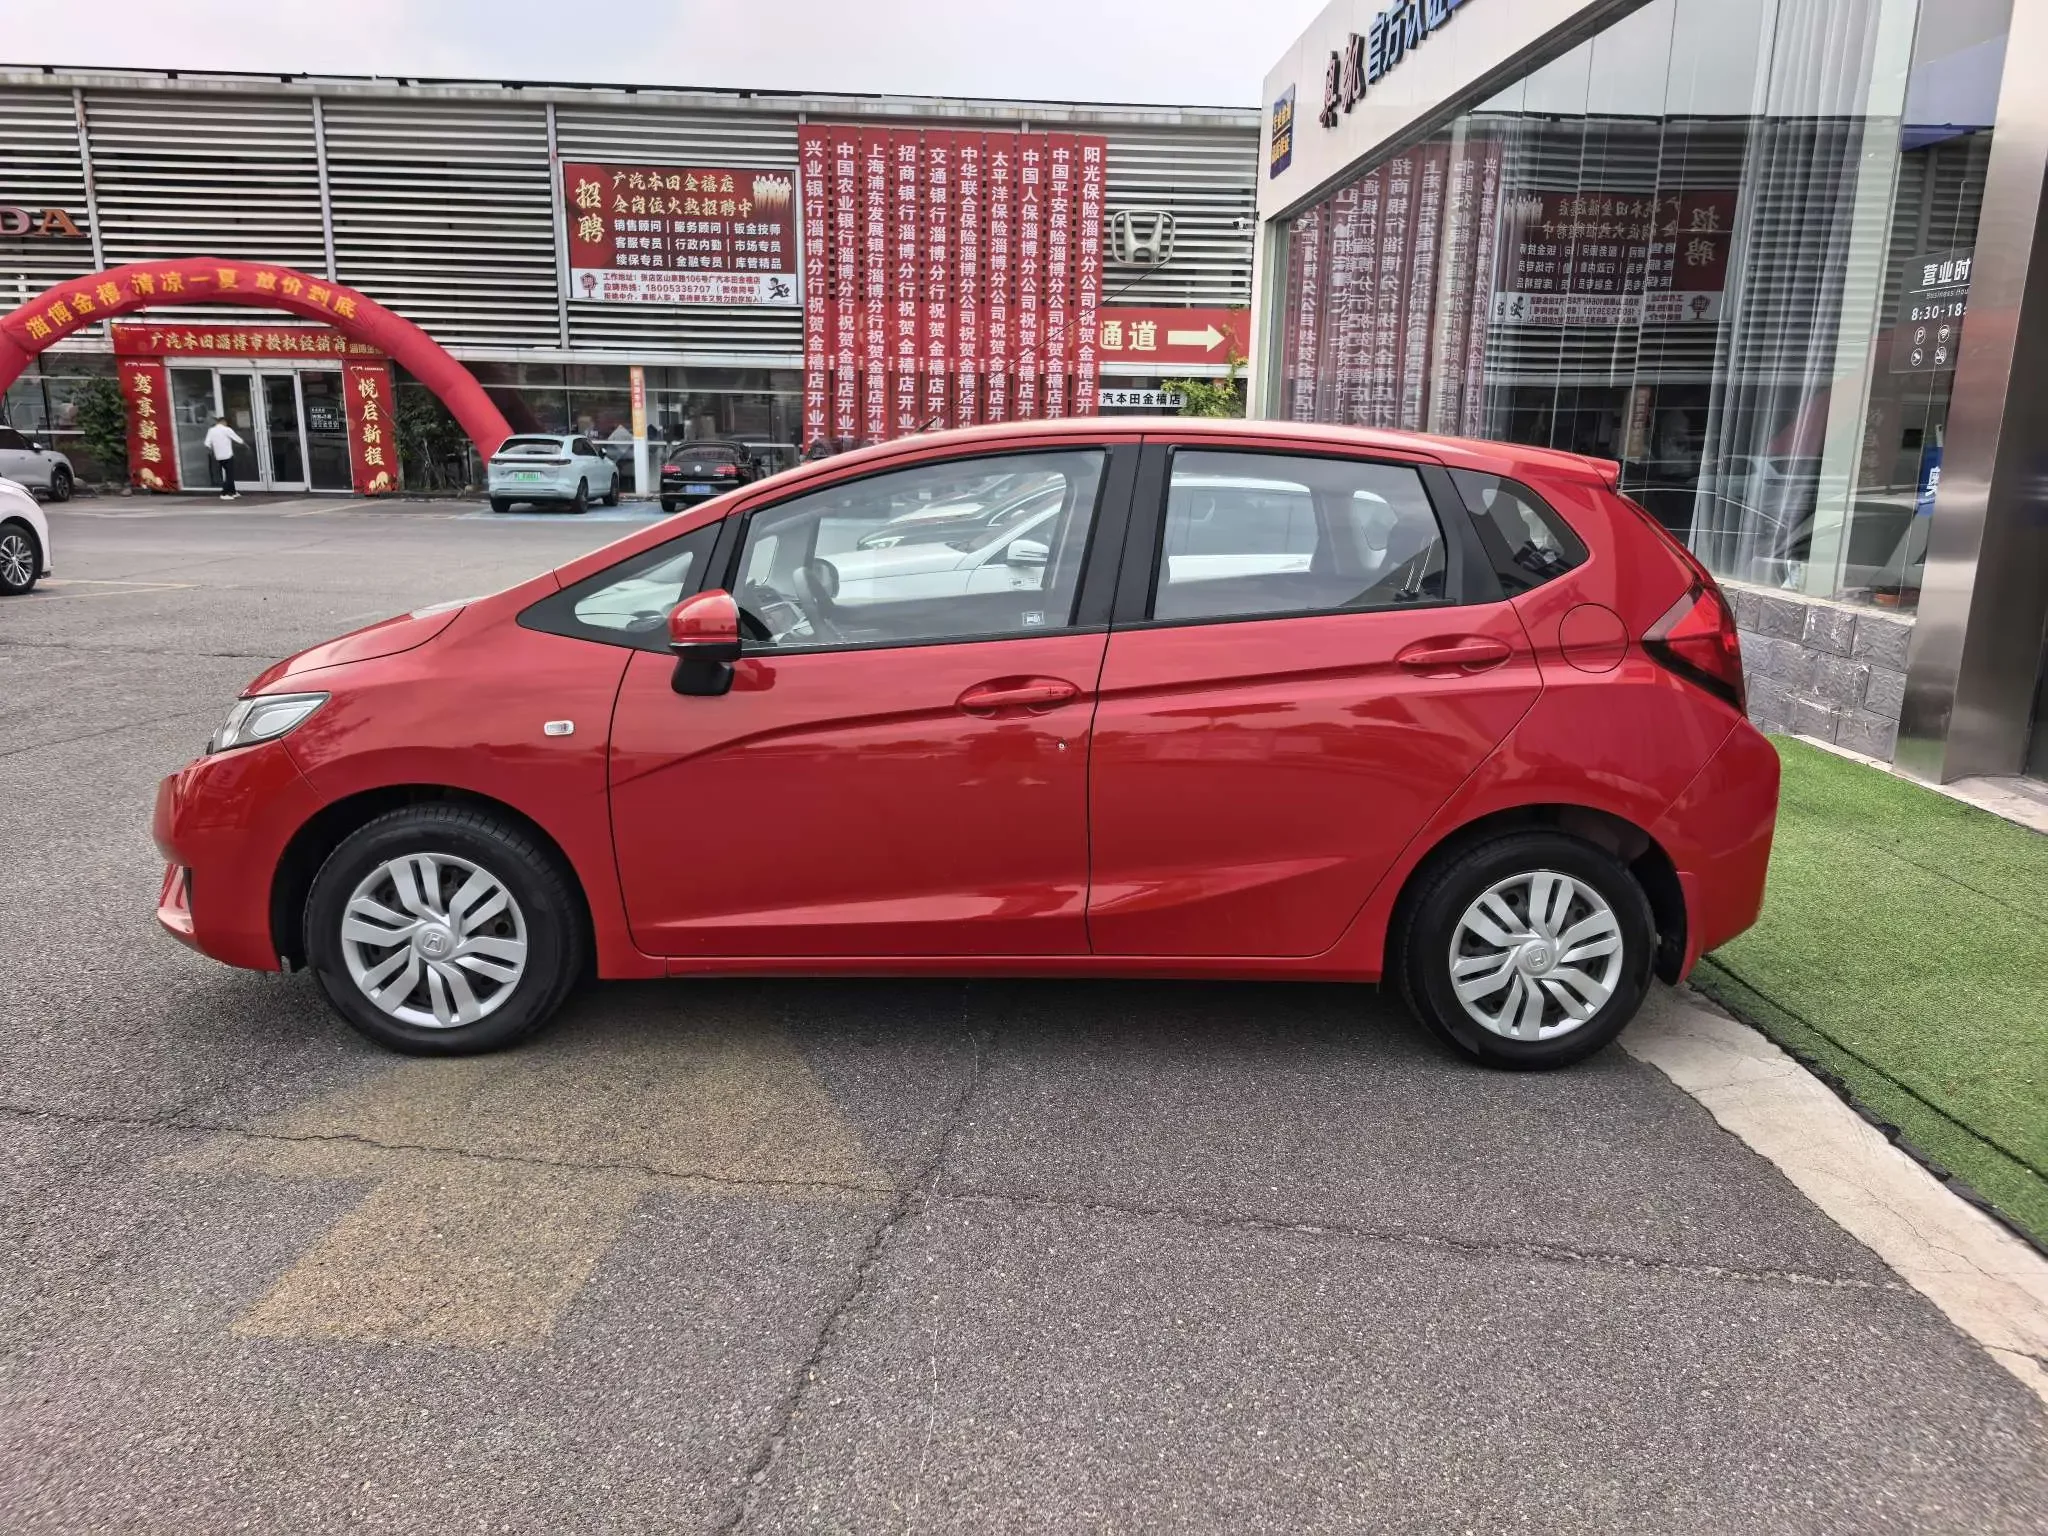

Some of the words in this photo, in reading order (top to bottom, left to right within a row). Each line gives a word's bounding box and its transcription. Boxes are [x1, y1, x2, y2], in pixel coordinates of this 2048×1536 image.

[611, 171, 735, 193] 广汽本田金禧店
[575, 178, 605, 243] 招聘
[611, 193, 753, 218] 全岗位火热招聘中
[614, 219, 662, 233] 销售顾问
[674, 221, 721, 234] 服务顾问
[734, 223, 781, 236] 钣金技师
[615, 237, 663, 250] 客服专员
[675, 239, 722, 251] 行政内勤
[735, 240, 781, 253] 市场专员
[676, 255, 723, 269] 金融专员
[1922, 258, 1971, 286] 营业时
[897, 144, 917, 435] 招商银行淄博分行祝贺金禧店开业
[1018, 148, 1040, 420] 中国人保淄博分公司祝贺金禧店开
[25, 281, 121, 340] 淄博金禧
[131, 268, 238, 295] 清凉一夏
[256, 271, 359, 319] 放价到底
[1100, 320, 1157, 351] 通道
[1098, 392, 1181, 405] 汽本田金禧店
